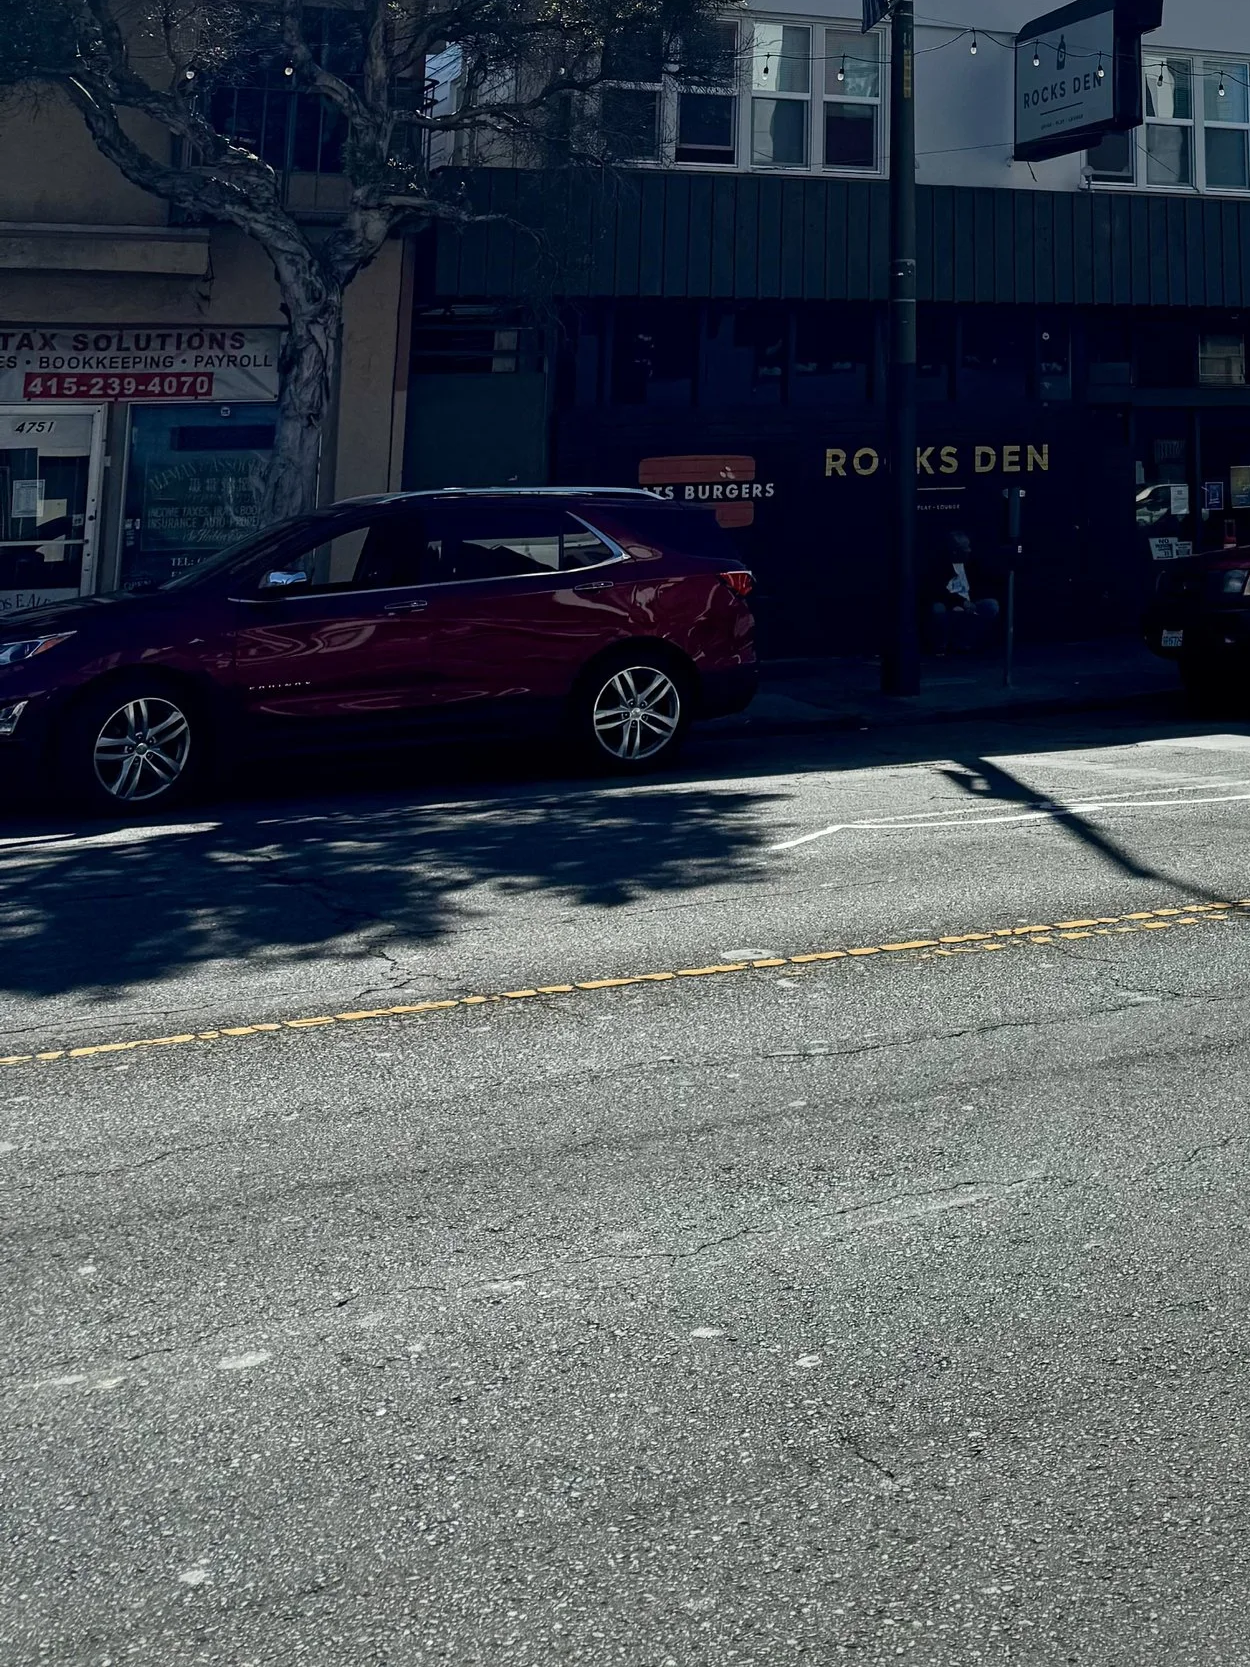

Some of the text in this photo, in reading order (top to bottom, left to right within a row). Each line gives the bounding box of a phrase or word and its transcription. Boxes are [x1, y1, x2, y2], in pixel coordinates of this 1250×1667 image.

[1023, 71, 1101, 109] ROCKS DEN
[0, 331, 246, 352] TAX SOLUTIONS
[39, 355, 174, 370] BOOKKEEPING
[194, 354, 273, 368] PAYROLL
[27, 376, 208, 396] 415-239-4070
[15, 421, 54, 434] 4751
[825, 444, 1049, 476] ROKS DEN
[685, 483, 774, 500] BURGERS
